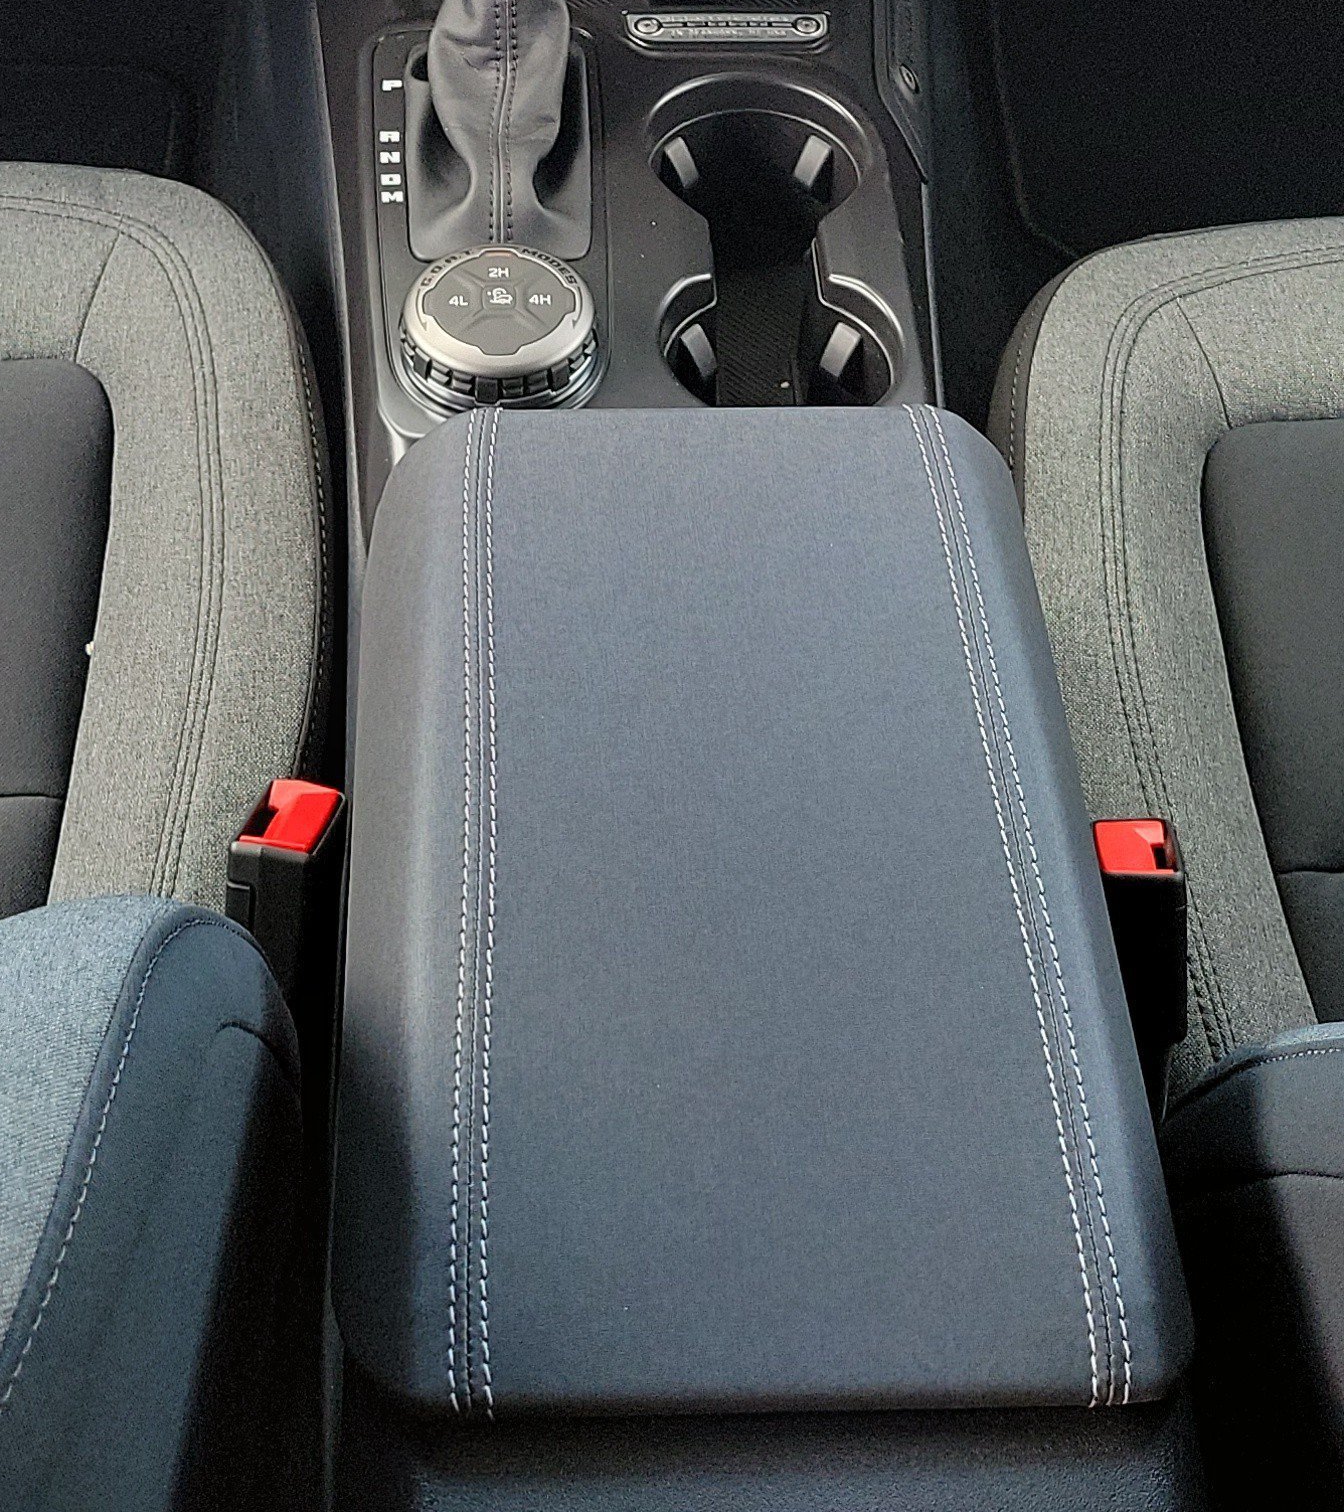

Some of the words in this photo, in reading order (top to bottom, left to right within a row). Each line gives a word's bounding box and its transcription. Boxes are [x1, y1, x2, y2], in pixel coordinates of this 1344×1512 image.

[382, 79, 403, 91] P
[379, 151, 401, 163] N
[380, 173, 401, 185] D
[381, 191, 404, 203] M
[488, 267, 509, 278] 2H
[521, 248, 578, 285] MODES
[448, 295, 468, 306] 4L
[529, 294, 551, 305] 4H
